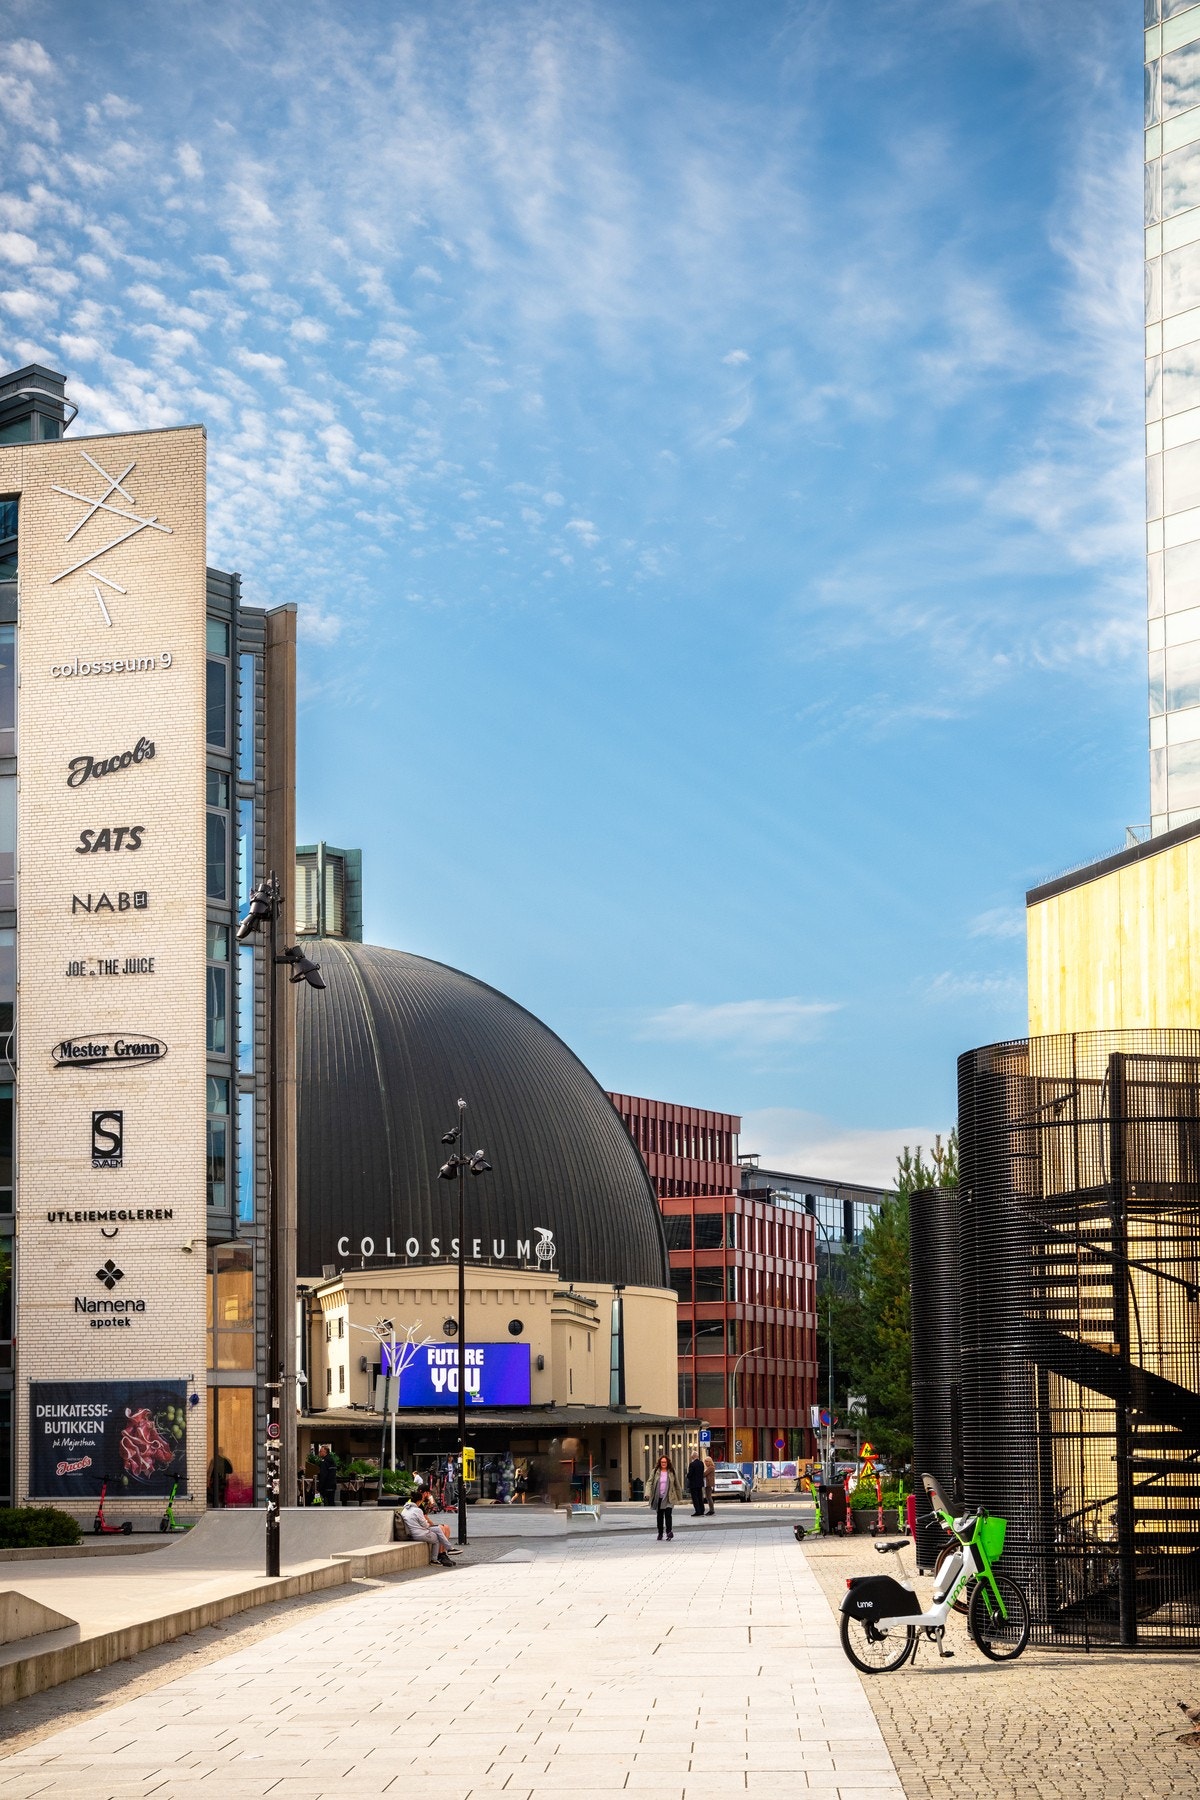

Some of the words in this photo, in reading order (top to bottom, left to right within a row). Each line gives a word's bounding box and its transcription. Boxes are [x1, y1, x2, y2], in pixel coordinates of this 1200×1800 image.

[50, 657, 155, 678] colosseum
[159, 652, 172, 669] 9
[66, 736, 156, 788] Jacob's
[75, 825, 146, 854] SATS
[65, 960, 86, 977] JOE
[98, 959, 119, 975] THE
[122, 957, 155, 975] JUICE
[60, 1042, 109, 1058] Mester
[114, 1040, 160, 1056] Grønn
[47, 1208, 173, 1222] UTLEIEMEGLEREN
[337, 1236, 531, 1260] COLOSSEUM
[74, 1296, 146, 1313] Namena
[90, 1316, 131, 1328] apotek
[431, 1367, 480, 1393] YOU
[36, 1404, 113, 1418] DELIKATESSE-
[44, 1421, 105, 1434] BUTIKKEN
[701, 1432, 709, 1441] P
[945, 1575, 967, 1608] Lime
